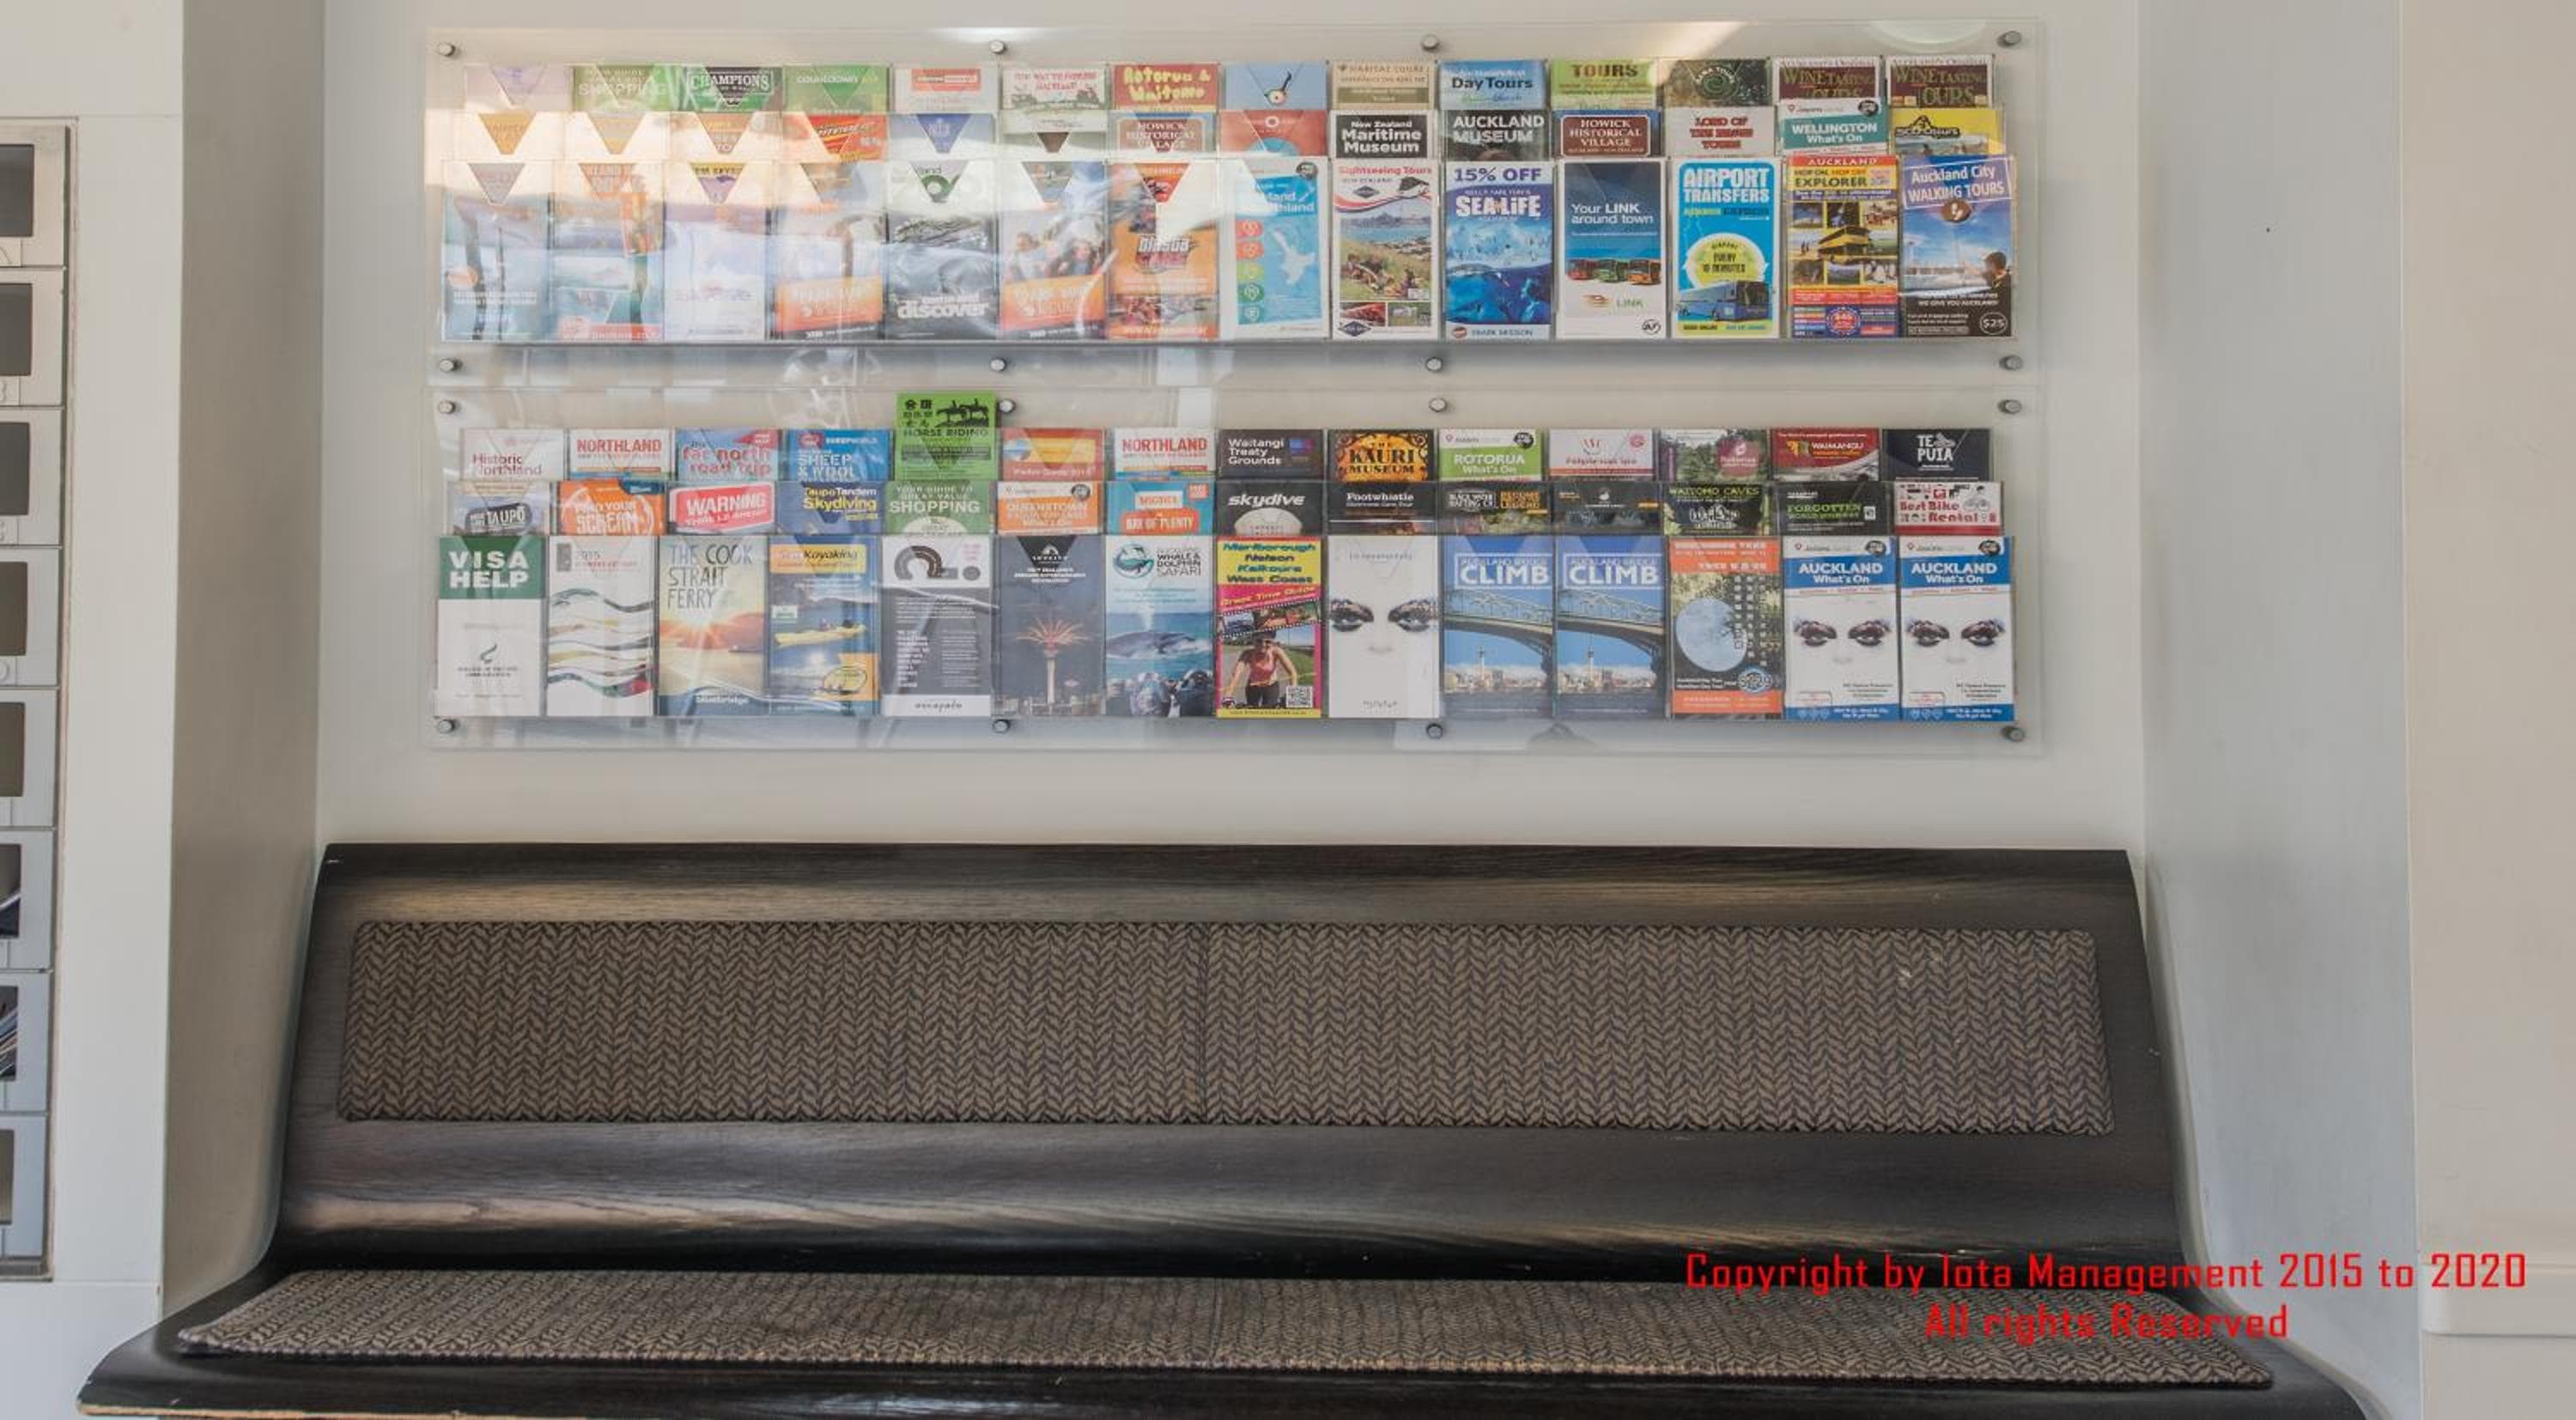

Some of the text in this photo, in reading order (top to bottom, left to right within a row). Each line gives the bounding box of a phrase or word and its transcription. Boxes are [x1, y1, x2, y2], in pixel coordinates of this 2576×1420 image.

[1125, 67, 1211, 83] Rotorua &
[1572, 64, 1638, 78] TOURS
[1783, 68, 1826, 84] WINE
[1895, 66, 1938, 83] WINE
[690, 74, 769, 89] CHAMPIONS
[1452, 77, 1533, 91] Day Tours
[1129, 85, 1205, 102] Waitomo
[1453, 116, 1545, 128] AUCKLAND
[1581, 119, 1631, 128] HOWICK
[1695, 117, 1728, 126] LORD
[1570, 129, 1642, 137] HISTORICAL
[1791, 123, 1878, 134] WELLINGTON
[1342, 130, 1422, 142] Maritime
[1453, 130, 1533, 143] MUSEUM
[1806, 134, 1863, 143] What's On
[1344, 142, 1419, 153] Museum
[1455, 168, 1542, 181] 15% OFF
[1683, 168, 1770, 187] AIRPORT
[1911, 164, 1996, 182] Auckland City
[1795, 177, 1868, 187] EXPLORER
[1684, 189, 1770, 203] TRANSFERS
[1908, 182, 2005, 203] WALKING TOURS
[1455, 196, 1495, 216] SEA
[1571, 203, 1639, 214] Your LINK
[1571, 215, 1653, 224] around town
[897, 301, 988, 319] discover
[577, 440, 662, 452] NORTHLAND
[1122, 439, 1207, 452] NORTHLAND
[1228, 438, 1285, 448] Waitangi
[1917, 435, 1934, 446] TE
[473, 454, 523, 464] Historic
[1229, 448, 1267, 458] Treaty
[1350, 449, 1415, 464] KAURI
[1917, 448, 1953, 462] PUIA
[798, 454, 852, 466] SHEEP
[1228, 457, 1282, 465] Grounds
[1455, 455, 1525, 464] ROTORUA
[475, 464, 542, 476] orthland
[804, 488, 835, 496] Taupo
[1346, 493, 1414, 502] Footwhistle
[687, 493, 766, 515] WARNING
[804, 496, 878, 513] Skydiving
[1228, 494, 1306, 507] skydive
[1900, 501, 1959, 511] Best Bike
[890, 501, 980, 513] SHOPPING
[1787, 504, 1862, 513] FORGOTTEN
[487, 507, 526, 524] TAUPO
[1929, 513, 1978, 522] Rental
[1223, 543, 1316, 552] Marlborough
[449, 551, 529, 569] VISA
[706, 544, 752, 564] COOK
[1799, 563, 1884, 574] AUCKLAND
[1911, 562, 1997, 574] AUCKLAND
[449, 571, 528, 588] HELP
[669, 567, 728, 586] STRAIT
[1461, 566, 1550, 585] CLIMB
[1570, 566, 1660, 585] CLIMB
[1814, 574, 1869, 584] What's On
[1925, 574, 1984, 584] What's On
[667, 588, 715, 609] FERRY
